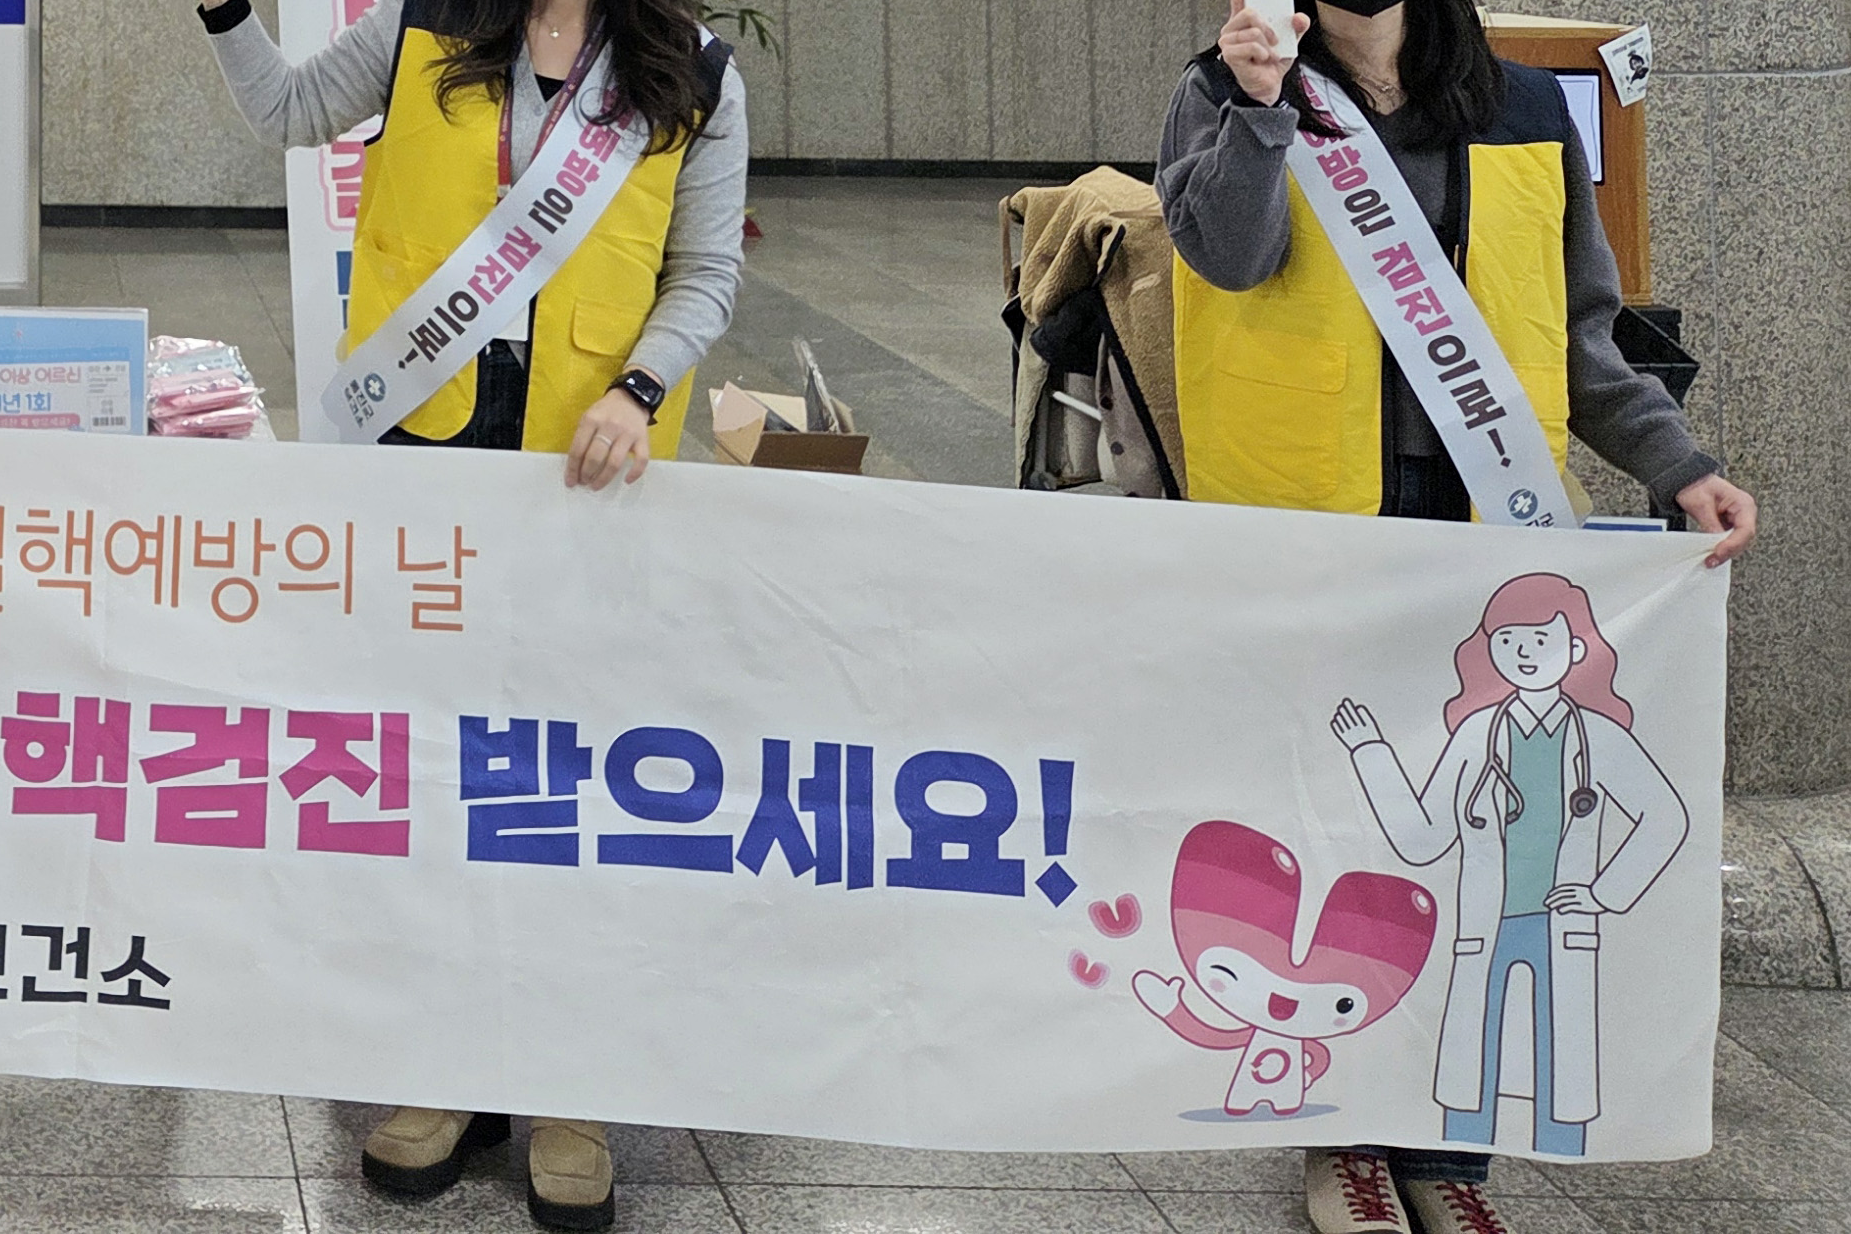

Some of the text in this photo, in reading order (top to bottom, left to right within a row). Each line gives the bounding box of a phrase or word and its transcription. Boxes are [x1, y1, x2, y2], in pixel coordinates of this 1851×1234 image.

[398, 225, 544, 370] 검진으로!
[1372, 241, 1511, 469] 검진으로!
[0, 365, 31, 385] 이상
[35, 365, 81, 384] 어르신
[25, 391, 52, 412] 1회
[396, 522, 479, 633] 날
[458, 714, 1079, 908] 받으세요!
